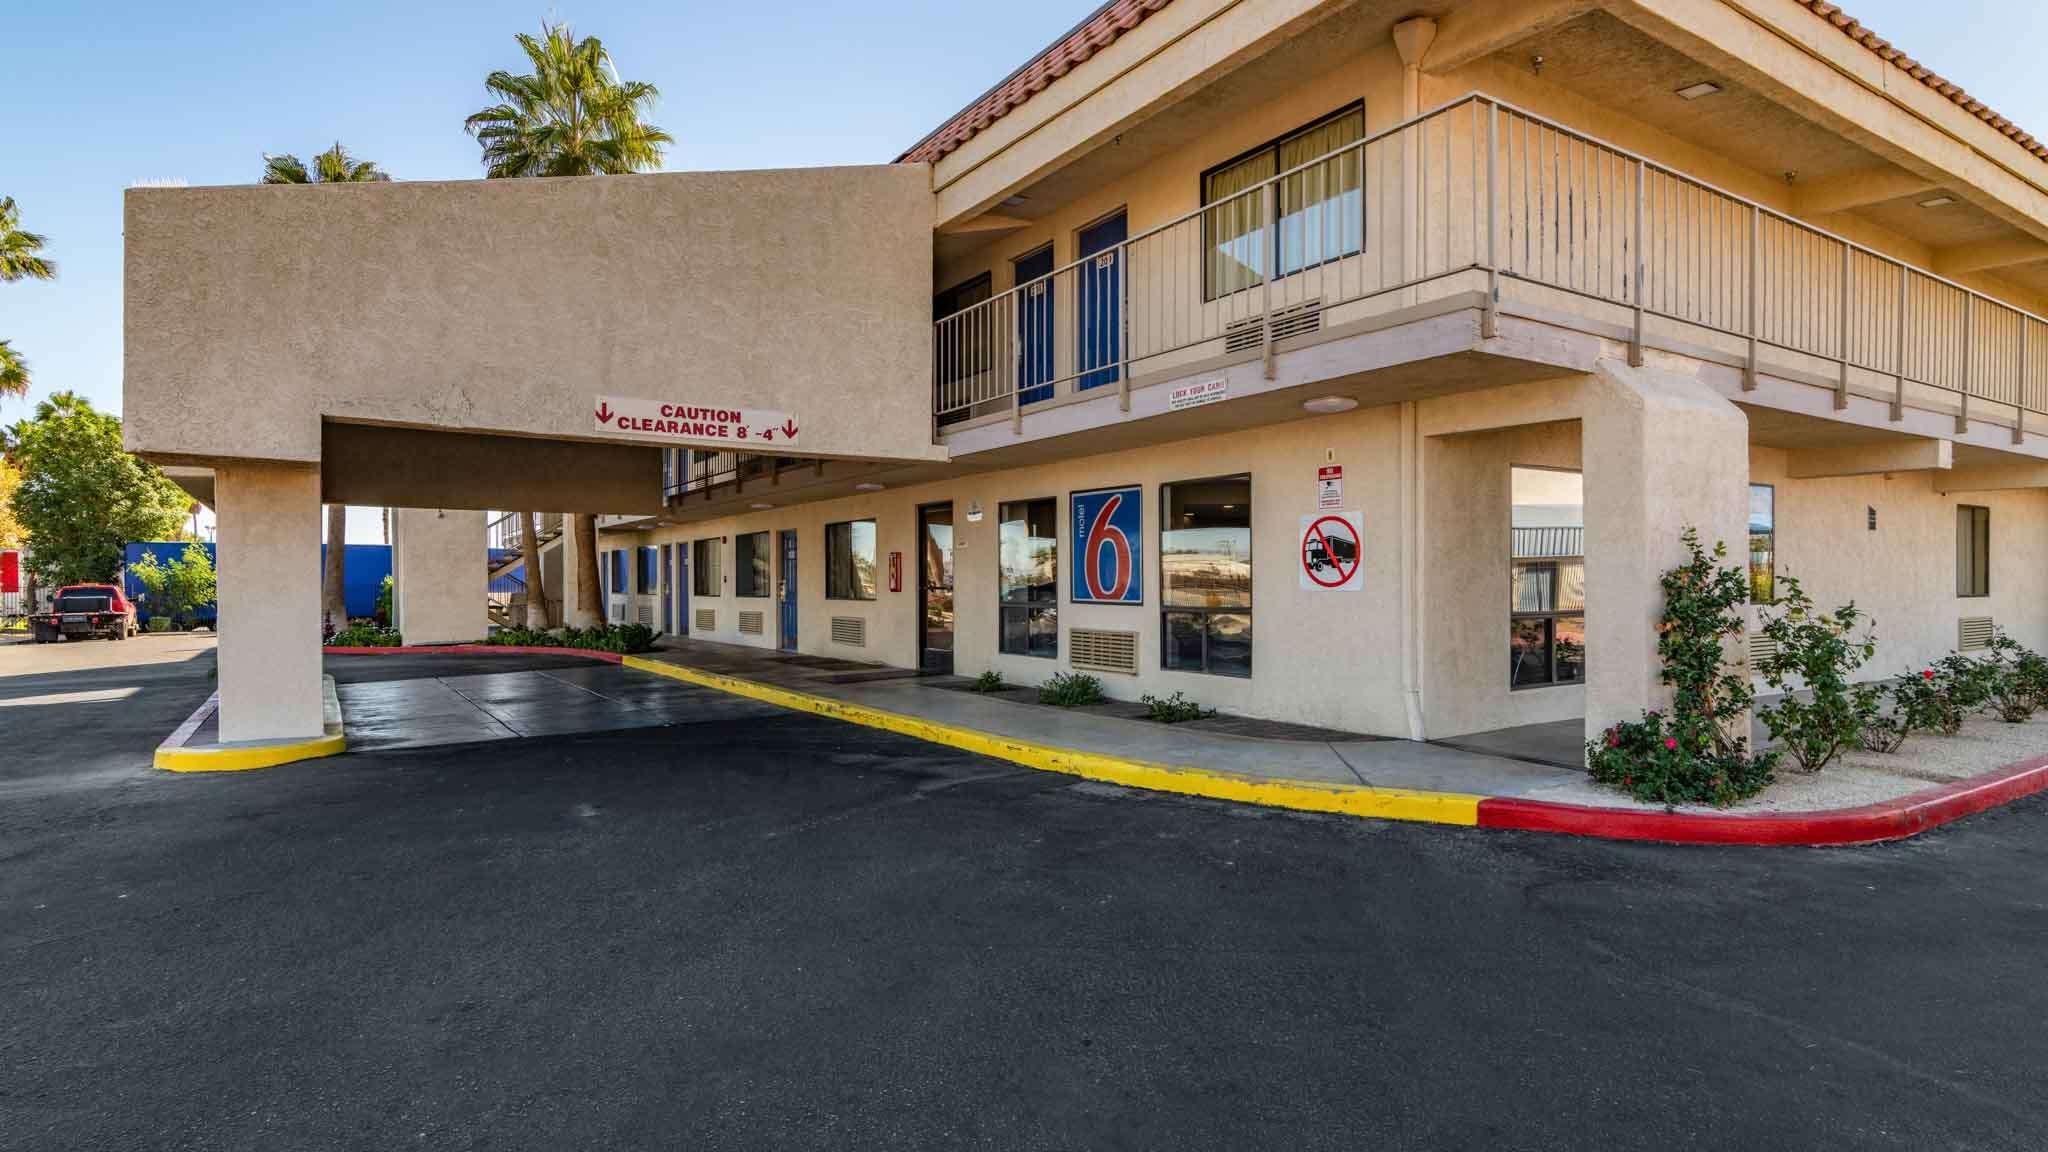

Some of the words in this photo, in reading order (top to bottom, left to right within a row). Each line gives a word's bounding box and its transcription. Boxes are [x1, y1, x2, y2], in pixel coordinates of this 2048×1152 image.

[660, 404, 742, 424] CAUTION
[617, 416, 729, 438] CLEARANCE
[1077, 504, 1086, 538] motel
[1084, 494, 1132, 600] 6
